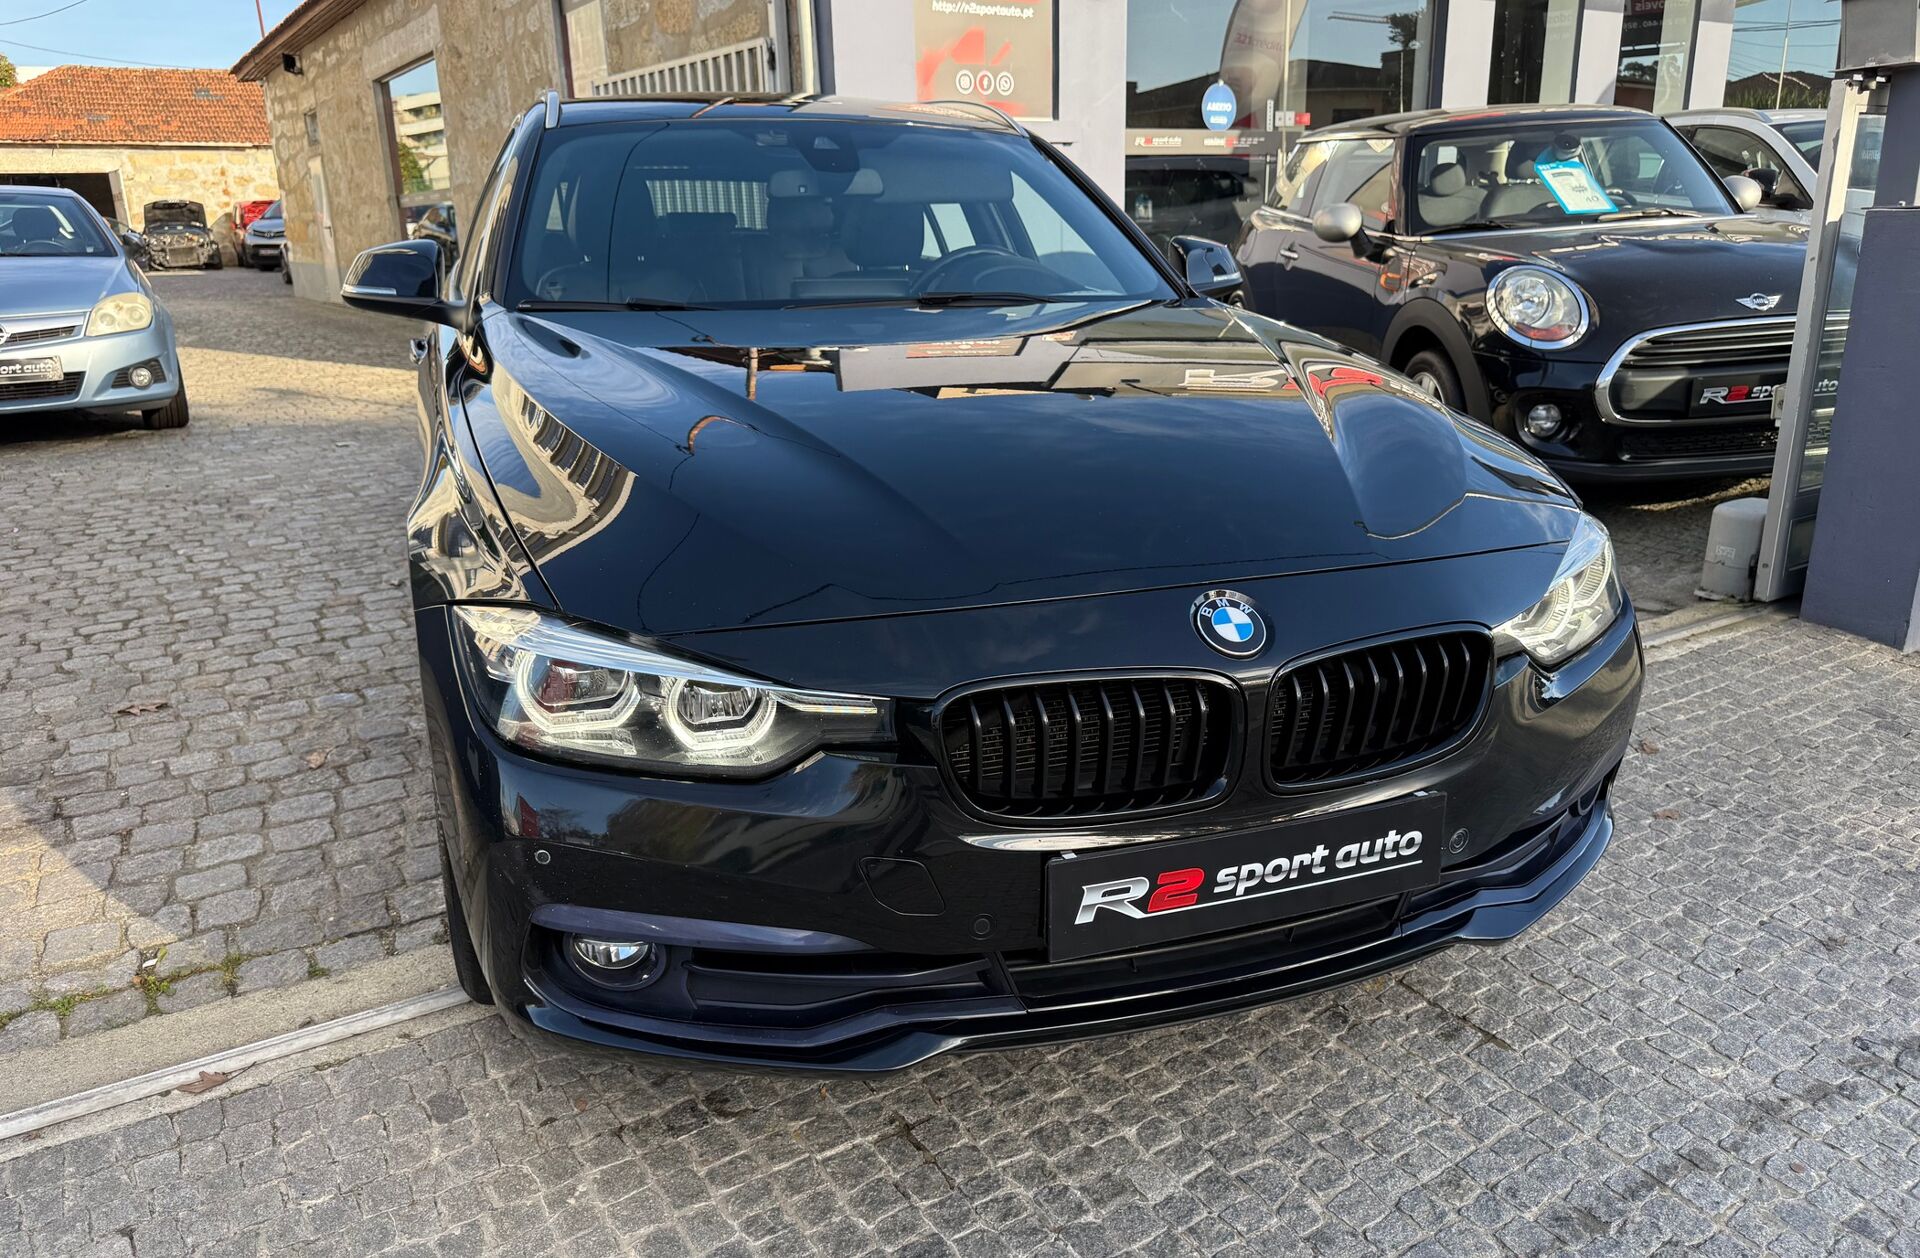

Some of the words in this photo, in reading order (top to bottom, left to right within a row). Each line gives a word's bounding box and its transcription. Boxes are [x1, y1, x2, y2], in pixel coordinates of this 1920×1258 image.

[932, 0, 1034, 19] http://r2sportauto.pt
[0, 363, 22, 374] ort
[23, 362, 53, 373] auto
[1699, 385, 1749, 404] R2
[1200, 598, 1253, 618] BMW
[1074, 867, 1205, 925] R2
[1213, 844, 1329, 896] sport
[1335, 829, 1423, 870] auto
